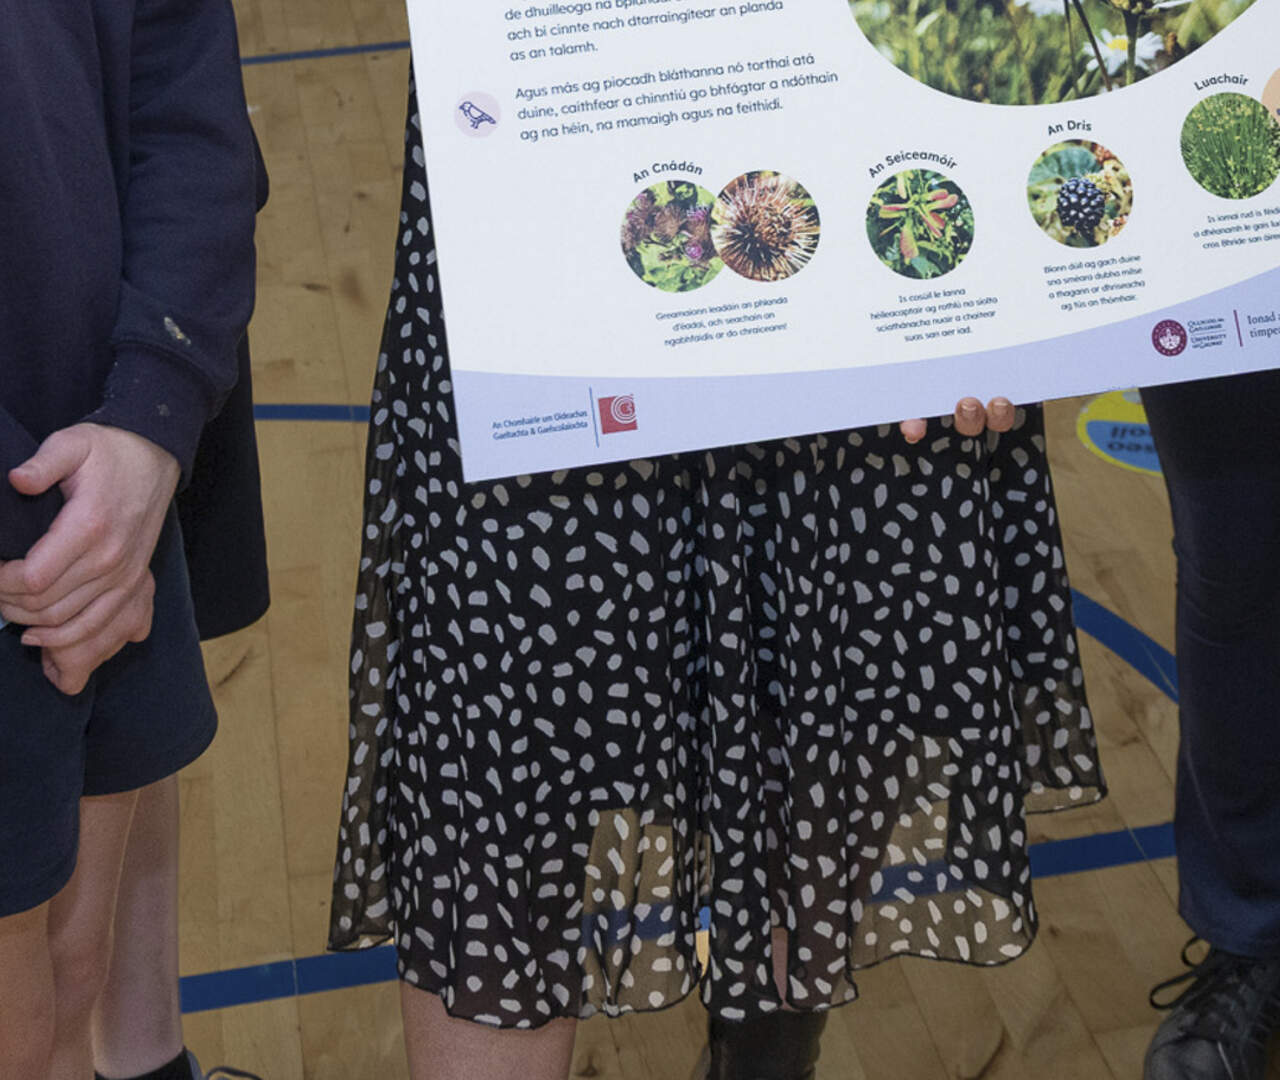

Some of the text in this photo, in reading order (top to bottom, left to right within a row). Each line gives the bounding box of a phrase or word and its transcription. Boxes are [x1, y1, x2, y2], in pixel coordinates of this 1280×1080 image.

[504, 8, 522, 20] de
[524, 2, 592, 18] dhuilleoga
[594, 0, 612, 10] na
[506, 27, 532, 41] ach
[549, 22, 590, 36] cinnte
[592, 16, 625, 30] nach
[718, 6, 736, 16] an
[738, 0, 783, 16] planda
[509, 40, 598, 61] as an talamh.
[515, 86, 548, 101] Agus
[550, 81, 580, 94] más
[581, 80, 600, 93] ag
[602, 72, 656, 91] piocadh
[658, 66, 724, 82] bláthanna
[726, 61, 744, 73] nó
[792, 52, 815, 66] atá
[1194, 73, 1248, 91] Luachair
[516, 71, 838, 120] duine, caithfear a chinntiú go bhfágtar a ndóthain
[519, 129, 538, 142] ag
[541, 127, 559, 137] na
[561, 121, 593, 135] héin,
[595, 120, 613, 131] na
[615, 110, 678, 128] mamaigh
[680, 108, 714, 123] agus
[716, 106, 734, 116] na
[1048, 120, 1092, 136] An Dris
[633, 160, 703, 182] An Cnádán
[869, 150, 957, 178] An Seiceamóir
[1246, 310, 1276, 325] Ionad
